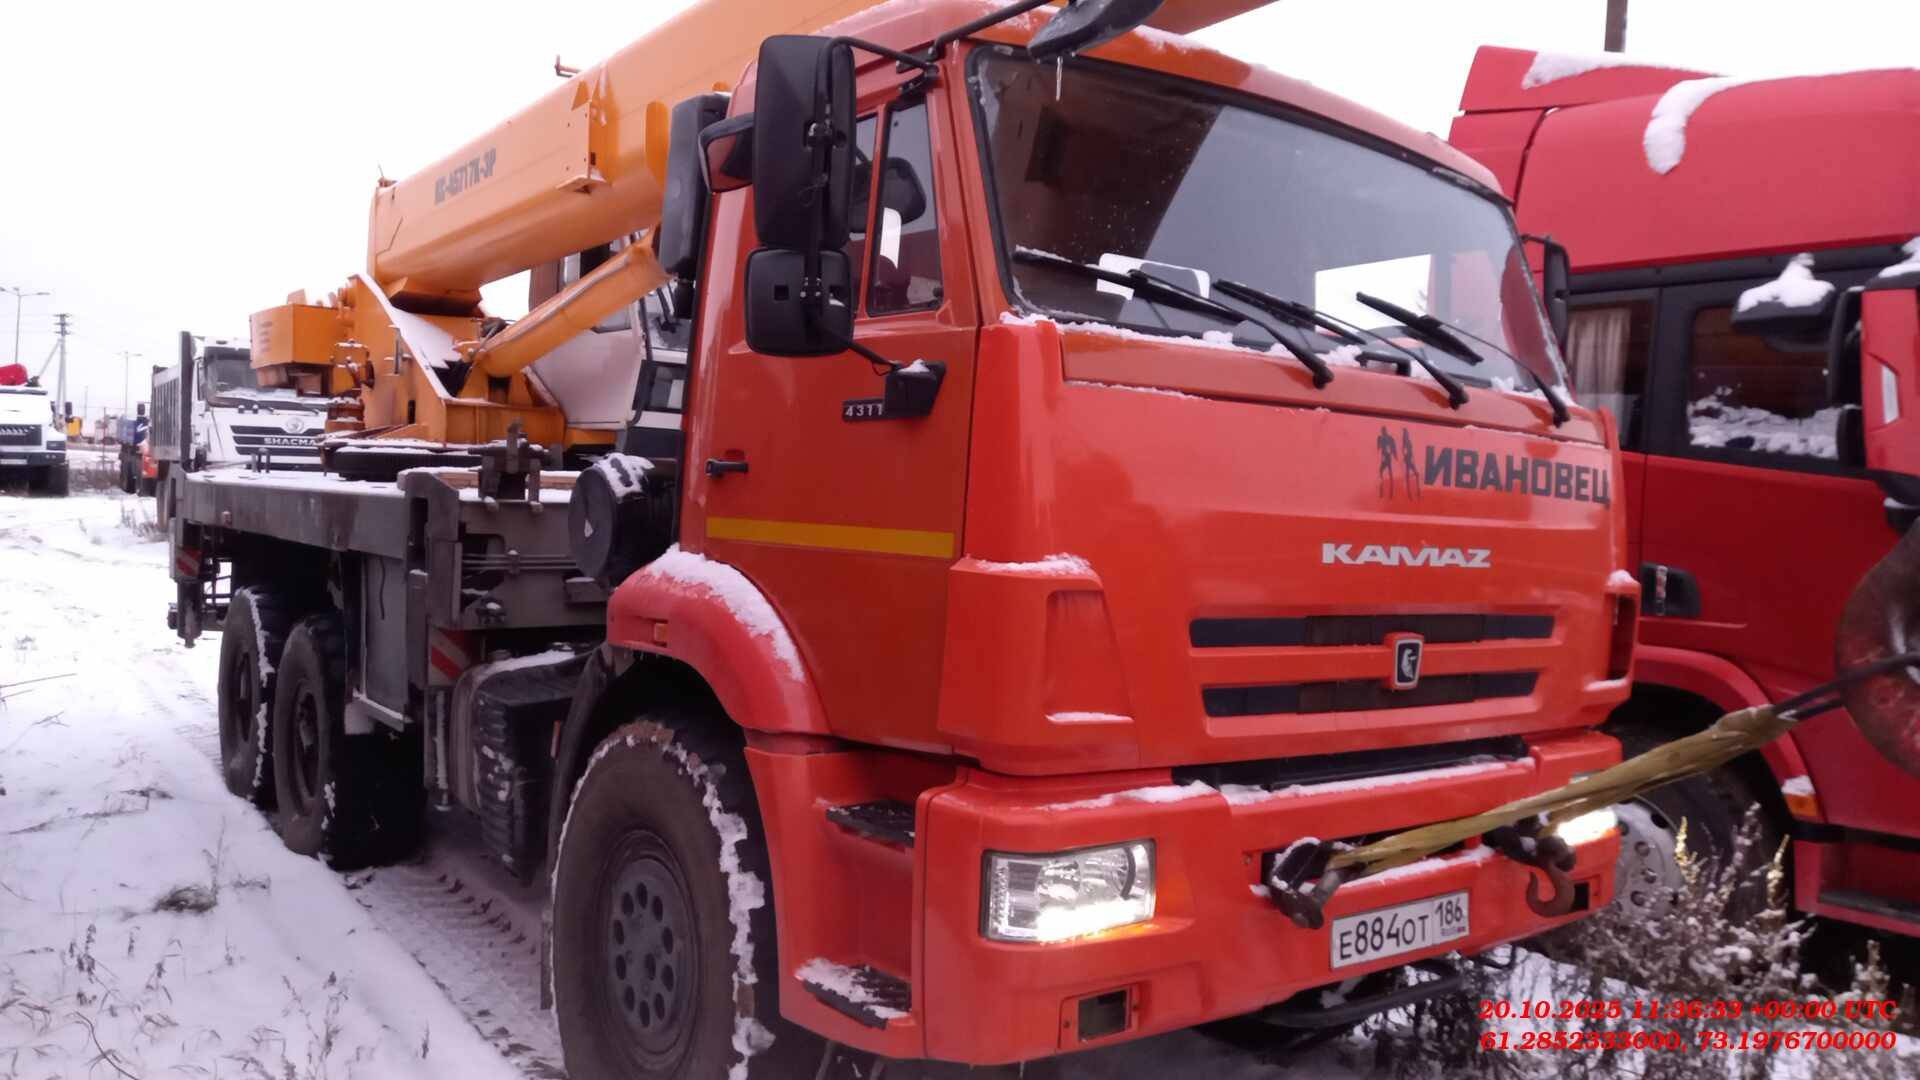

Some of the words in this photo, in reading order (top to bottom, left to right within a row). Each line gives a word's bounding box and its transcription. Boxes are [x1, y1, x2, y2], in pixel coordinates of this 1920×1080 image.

[1424, 445, 1611, 510] ИВАНОВЕЦ
[1321, 542, 1492, 568] KAMAZ
[1339, 912, 1429, 960] Е884ОТ
[1435, 899, 1463, 927] 186
